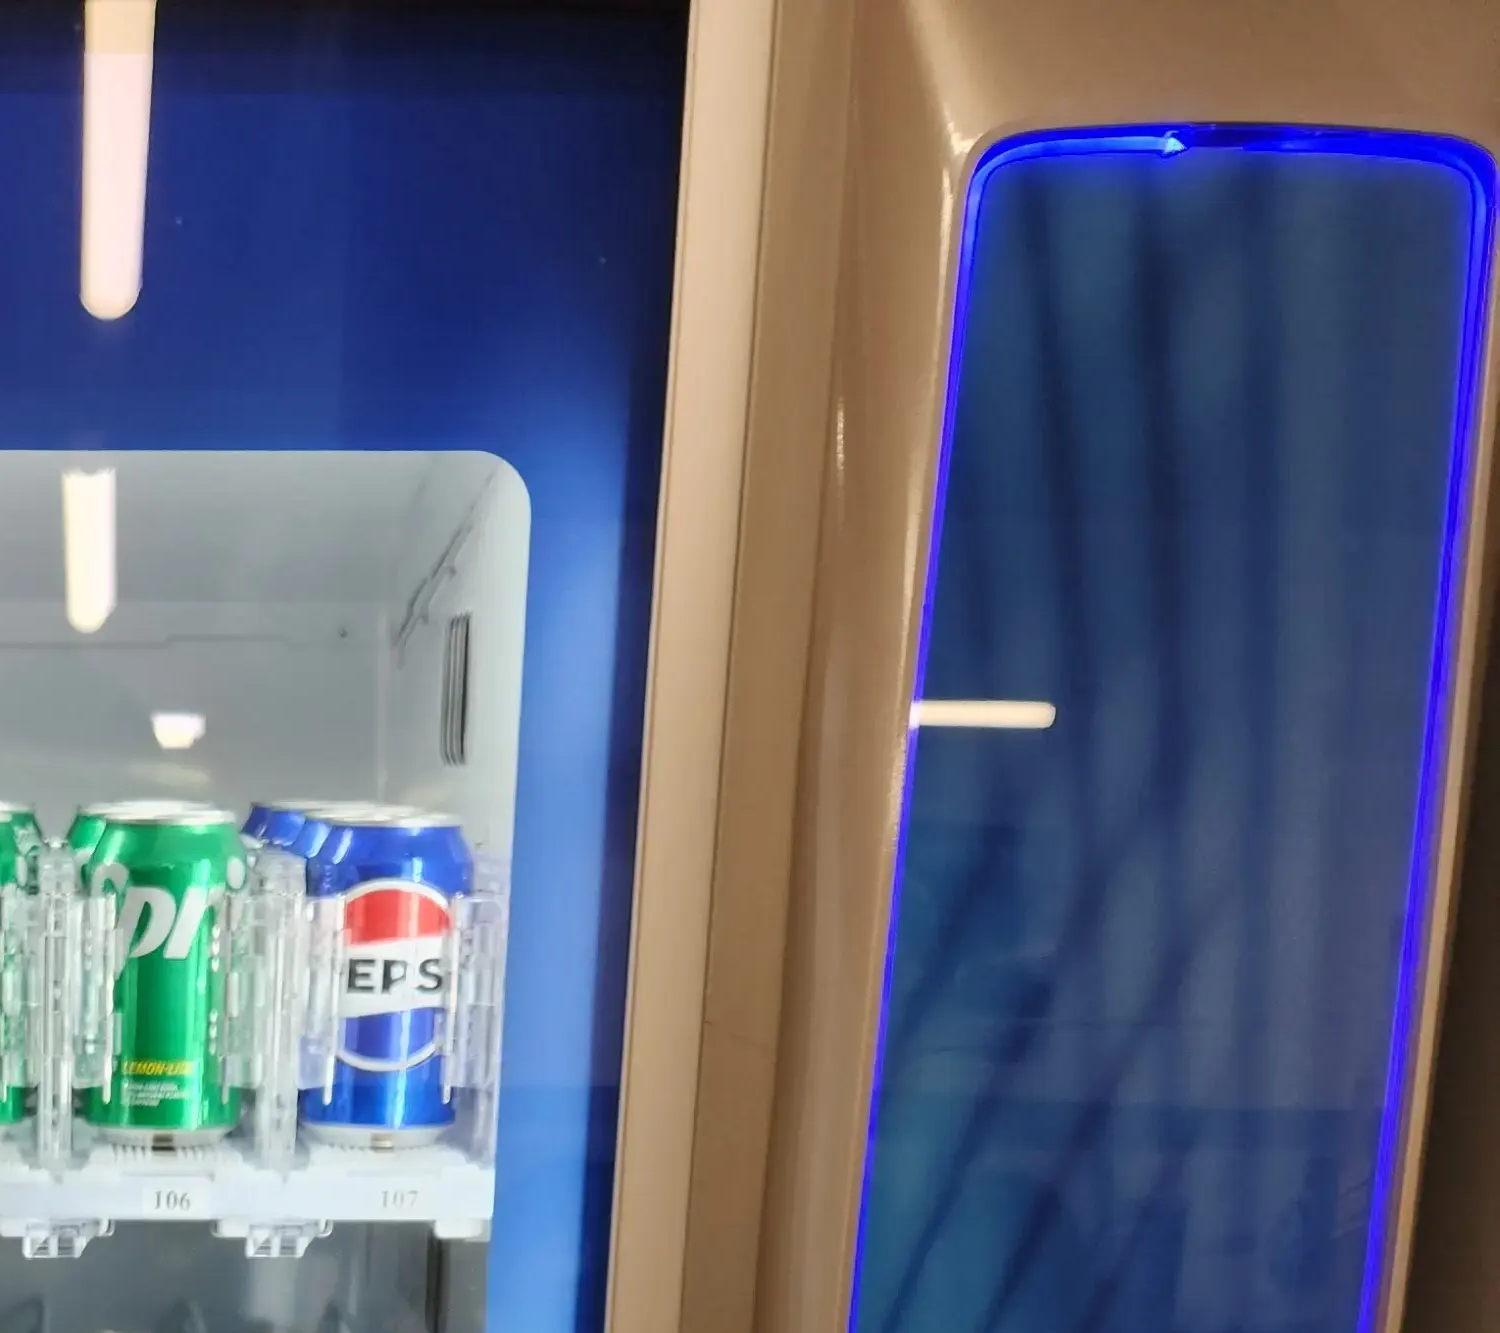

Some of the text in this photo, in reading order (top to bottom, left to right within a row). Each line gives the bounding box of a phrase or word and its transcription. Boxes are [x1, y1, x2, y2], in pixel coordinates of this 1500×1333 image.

[347, 958, 443, 994] EPS
[155, 1191, 190, 1209] 106
[382, 1190, 419, 1208] 107
